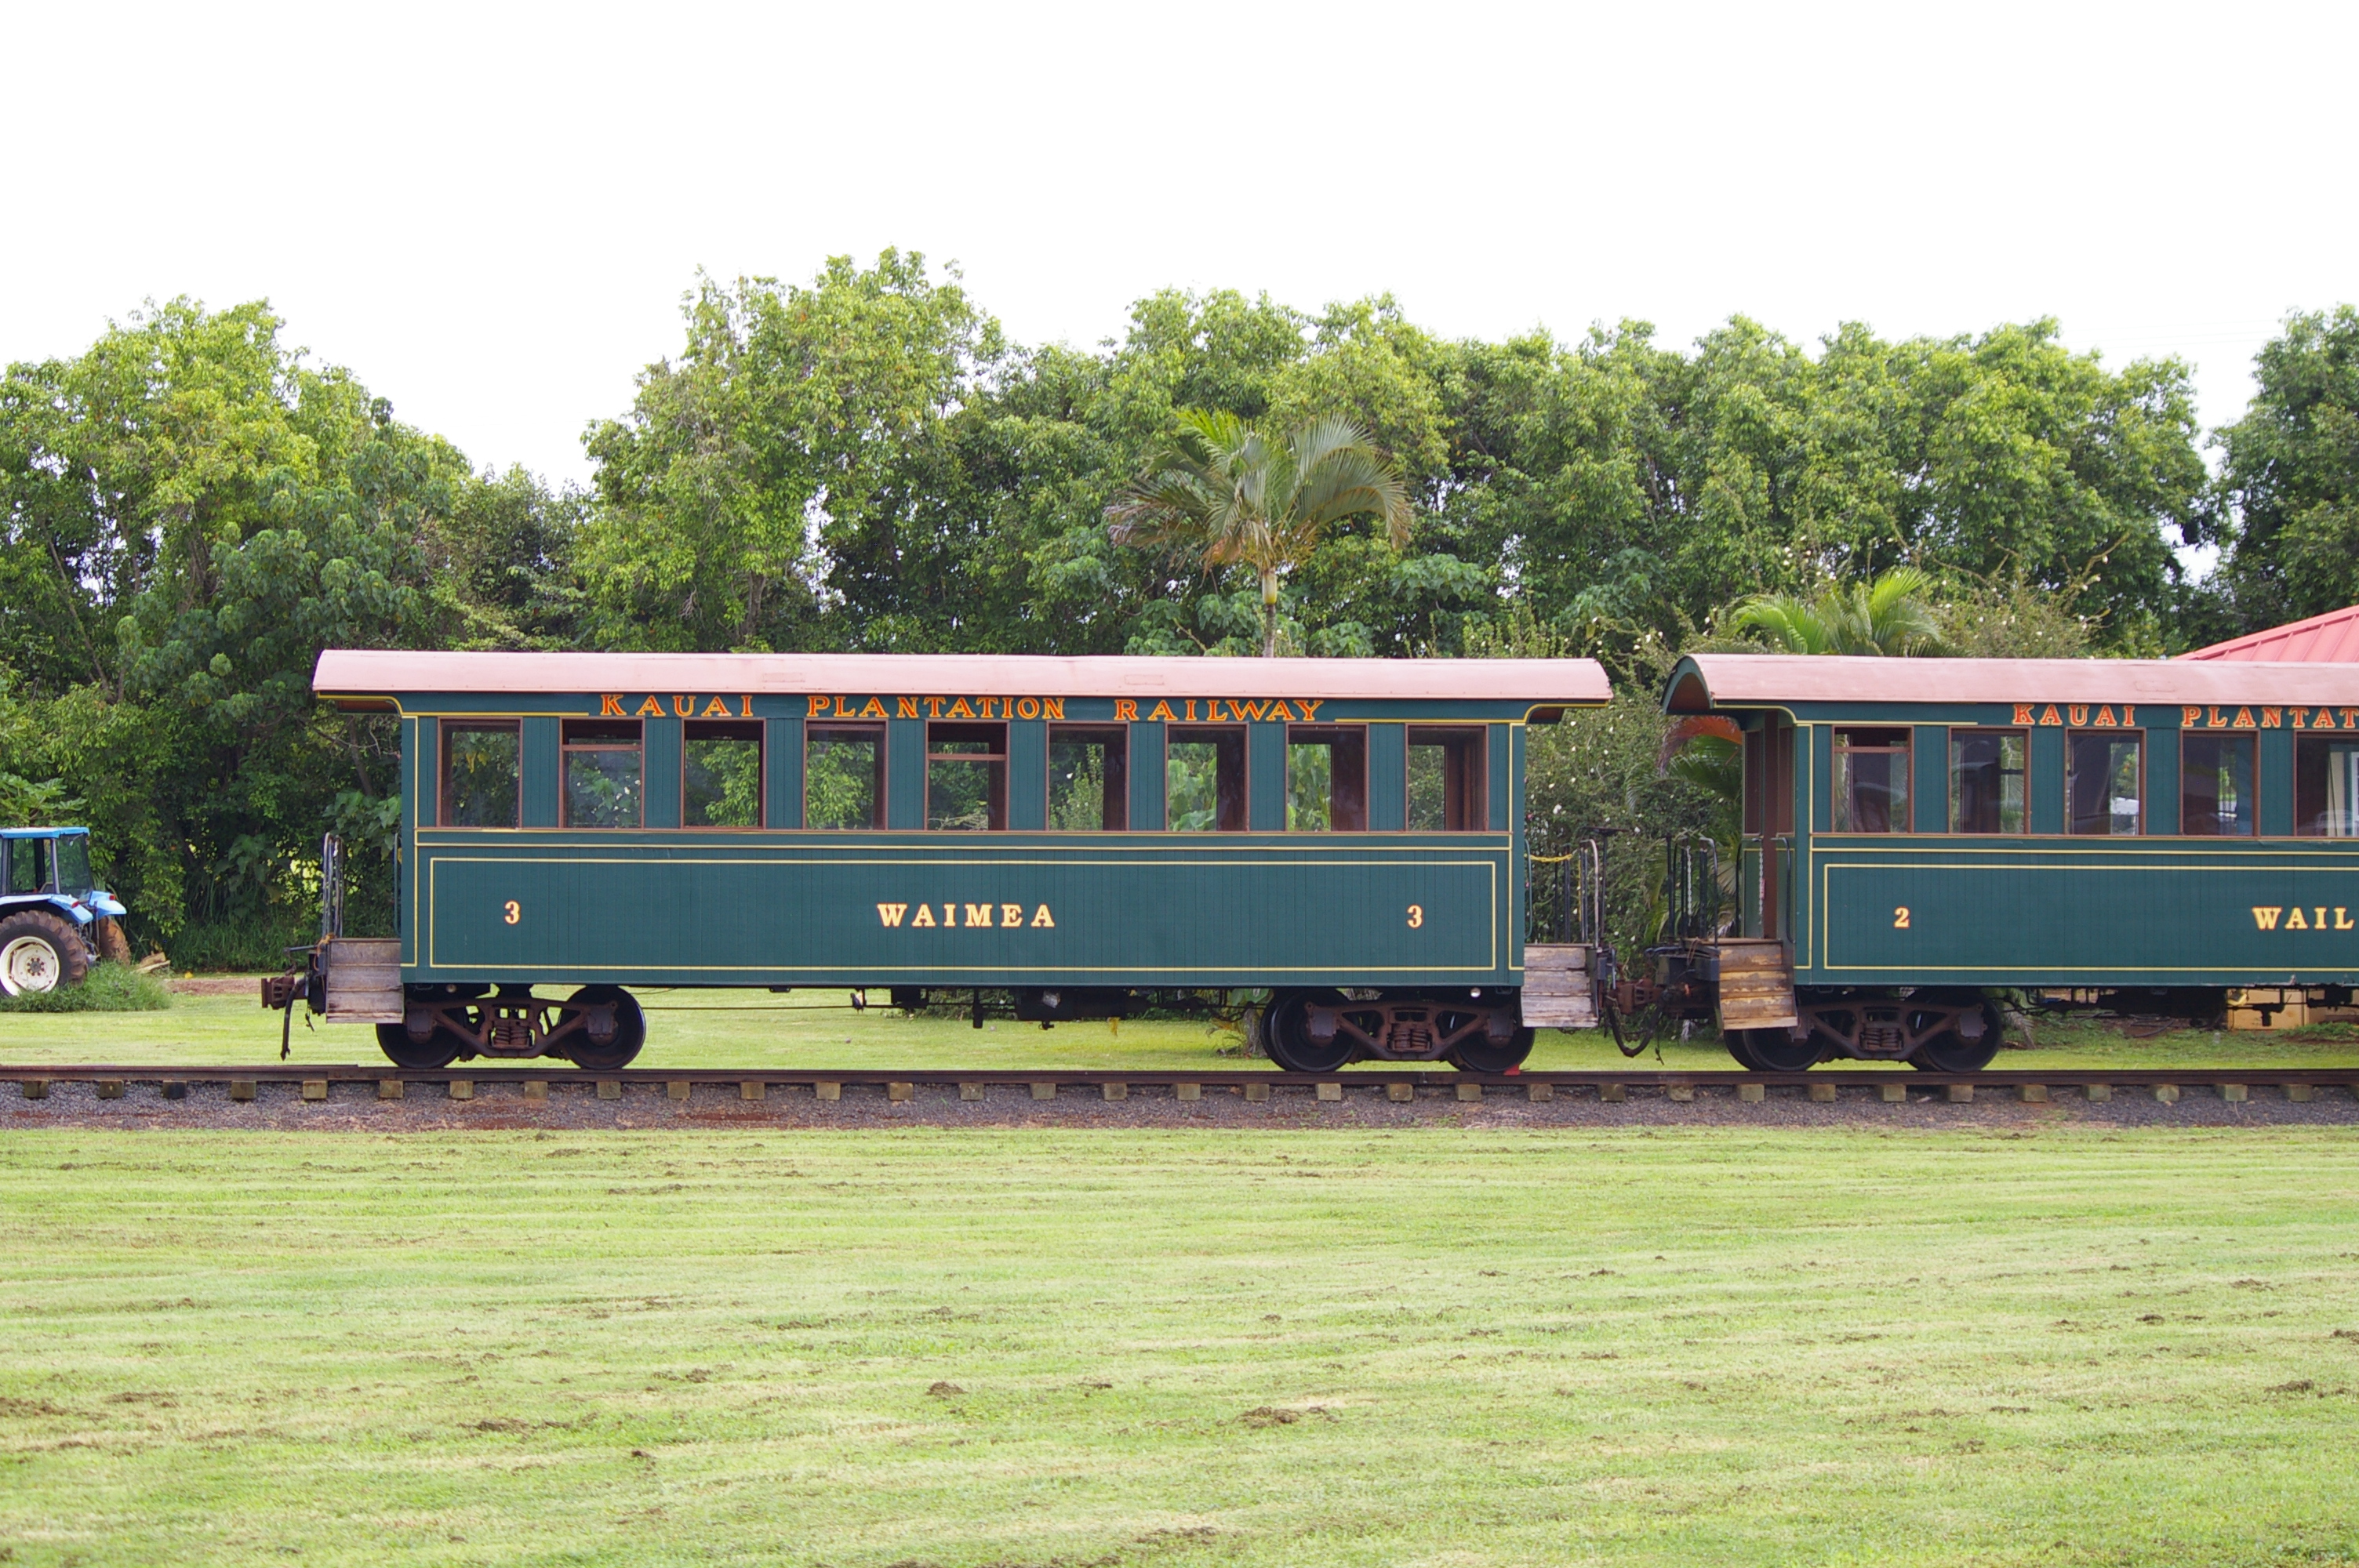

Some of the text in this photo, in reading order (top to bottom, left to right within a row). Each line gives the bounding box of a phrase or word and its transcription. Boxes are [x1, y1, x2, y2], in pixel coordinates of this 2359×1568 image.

[600, 695, 1323, 722] KAUAI PLANTATION RAILWAY
[2013, 705, 2359, 728] KAUAI PLANTAT
[504, 900, 521, 924] 3
[877, 903, 1055, 927] WAIMEA
[1407, 904, 1423, 928] 3
[1894, 906, 1910, 928] 2
[2252, 906, 2355, 931] WAIL
